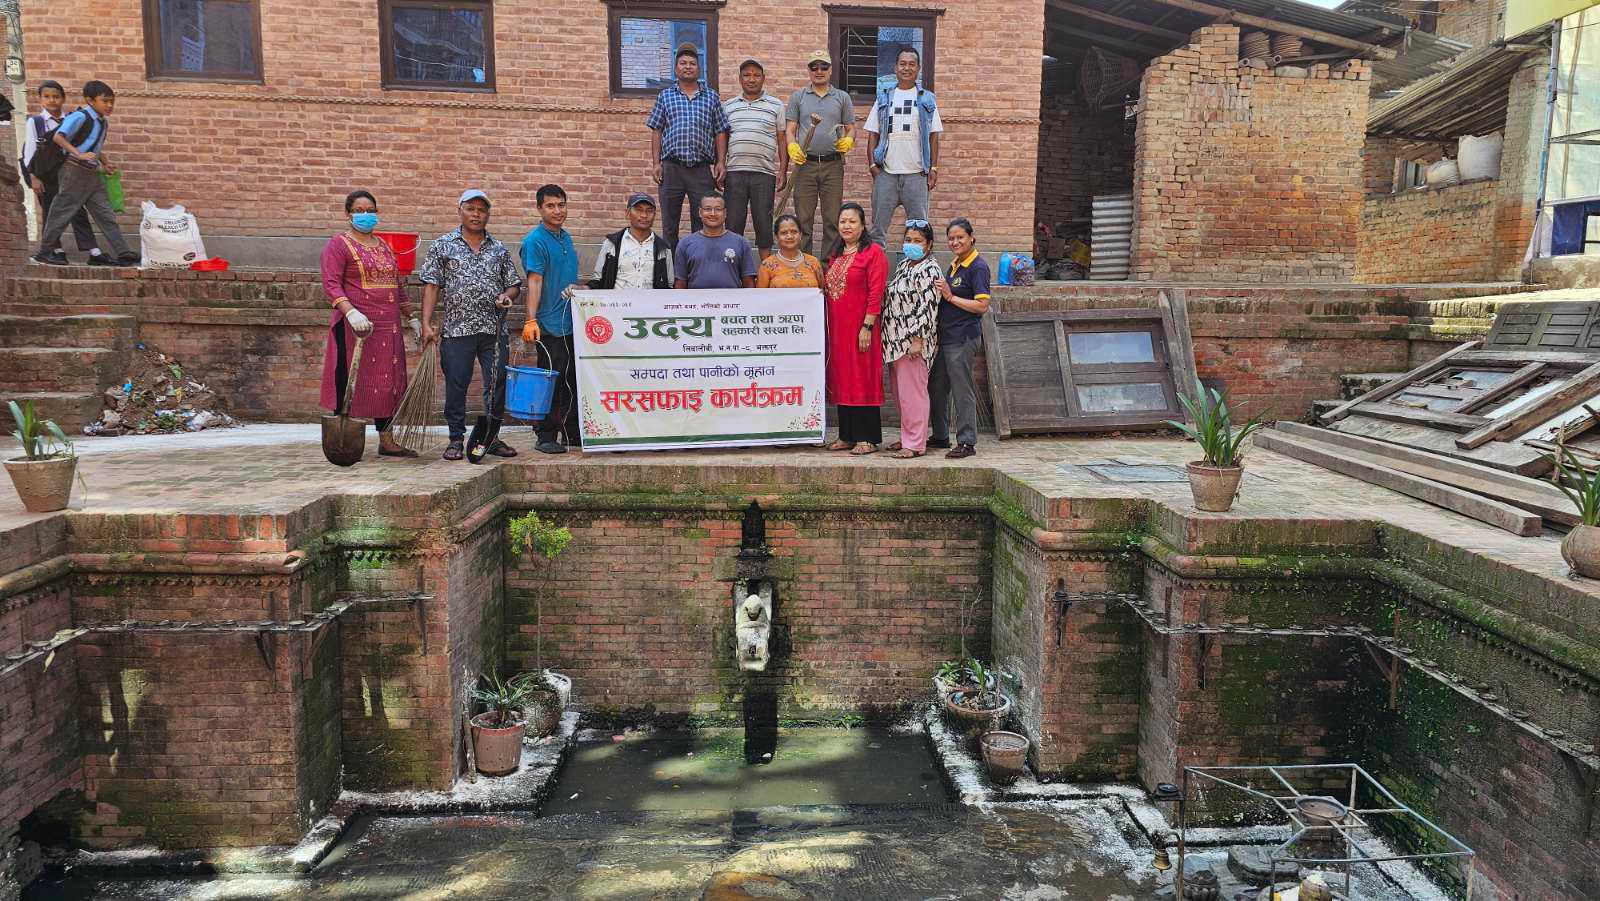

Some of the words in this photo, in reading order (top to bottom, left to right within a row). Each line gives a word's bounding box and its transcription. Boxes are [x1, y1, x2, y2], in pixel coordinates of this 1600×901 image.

[721, 315, 747, 325] बचत
[751, 315, 774, 324] तथा
[778, 314, 804, 324] ऋण
[622, 316, 716, 341] उदय
[721, 326, 760, 336] सहकारी
[763, 326, 788, 335] संस्था
[630, 368, 667, 380] सम्पदा
[672, 368, 695, 379] तथा
[699, 363, 739, 378] पानीको
[600, 389, 704, 413] सरसफाइ
[710, 382, 804, 409] कार्यक्रम
